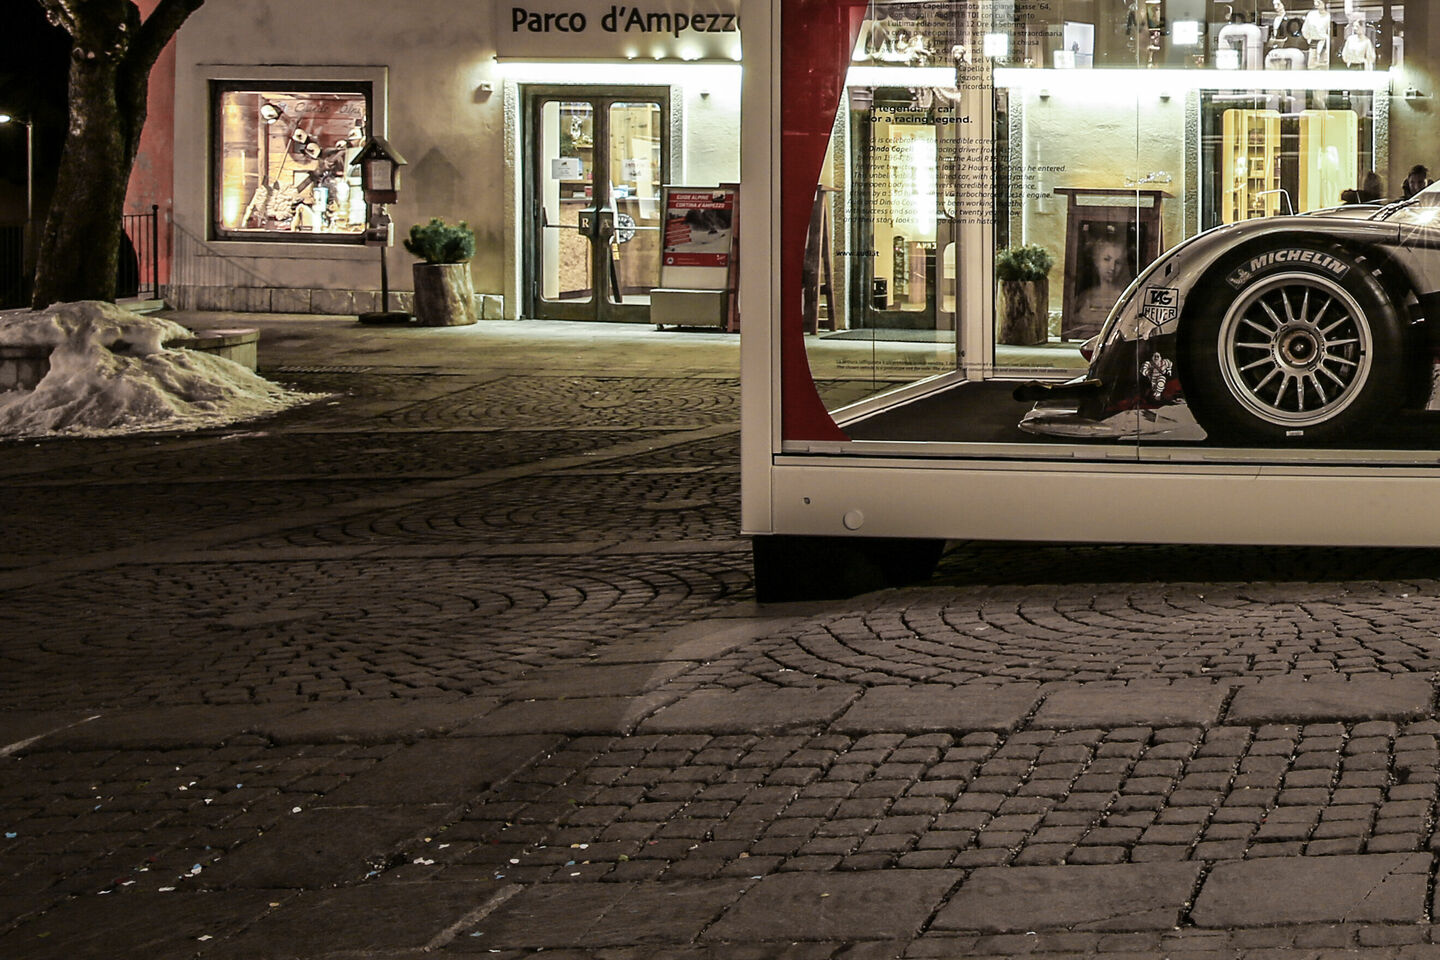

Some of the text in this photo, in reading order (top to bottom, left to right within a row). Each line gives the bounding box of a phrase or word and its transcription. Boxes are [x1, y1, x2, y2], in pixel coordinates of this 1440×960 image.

[511, 6, 741, 40] Parco d'Ampezz
[937, 106, 955, 114] car
[895, 115, 928, 126] racing
[1249, 249, 1347, 274] MICHELIN
[1150, 290, 1173, 306] TAG
